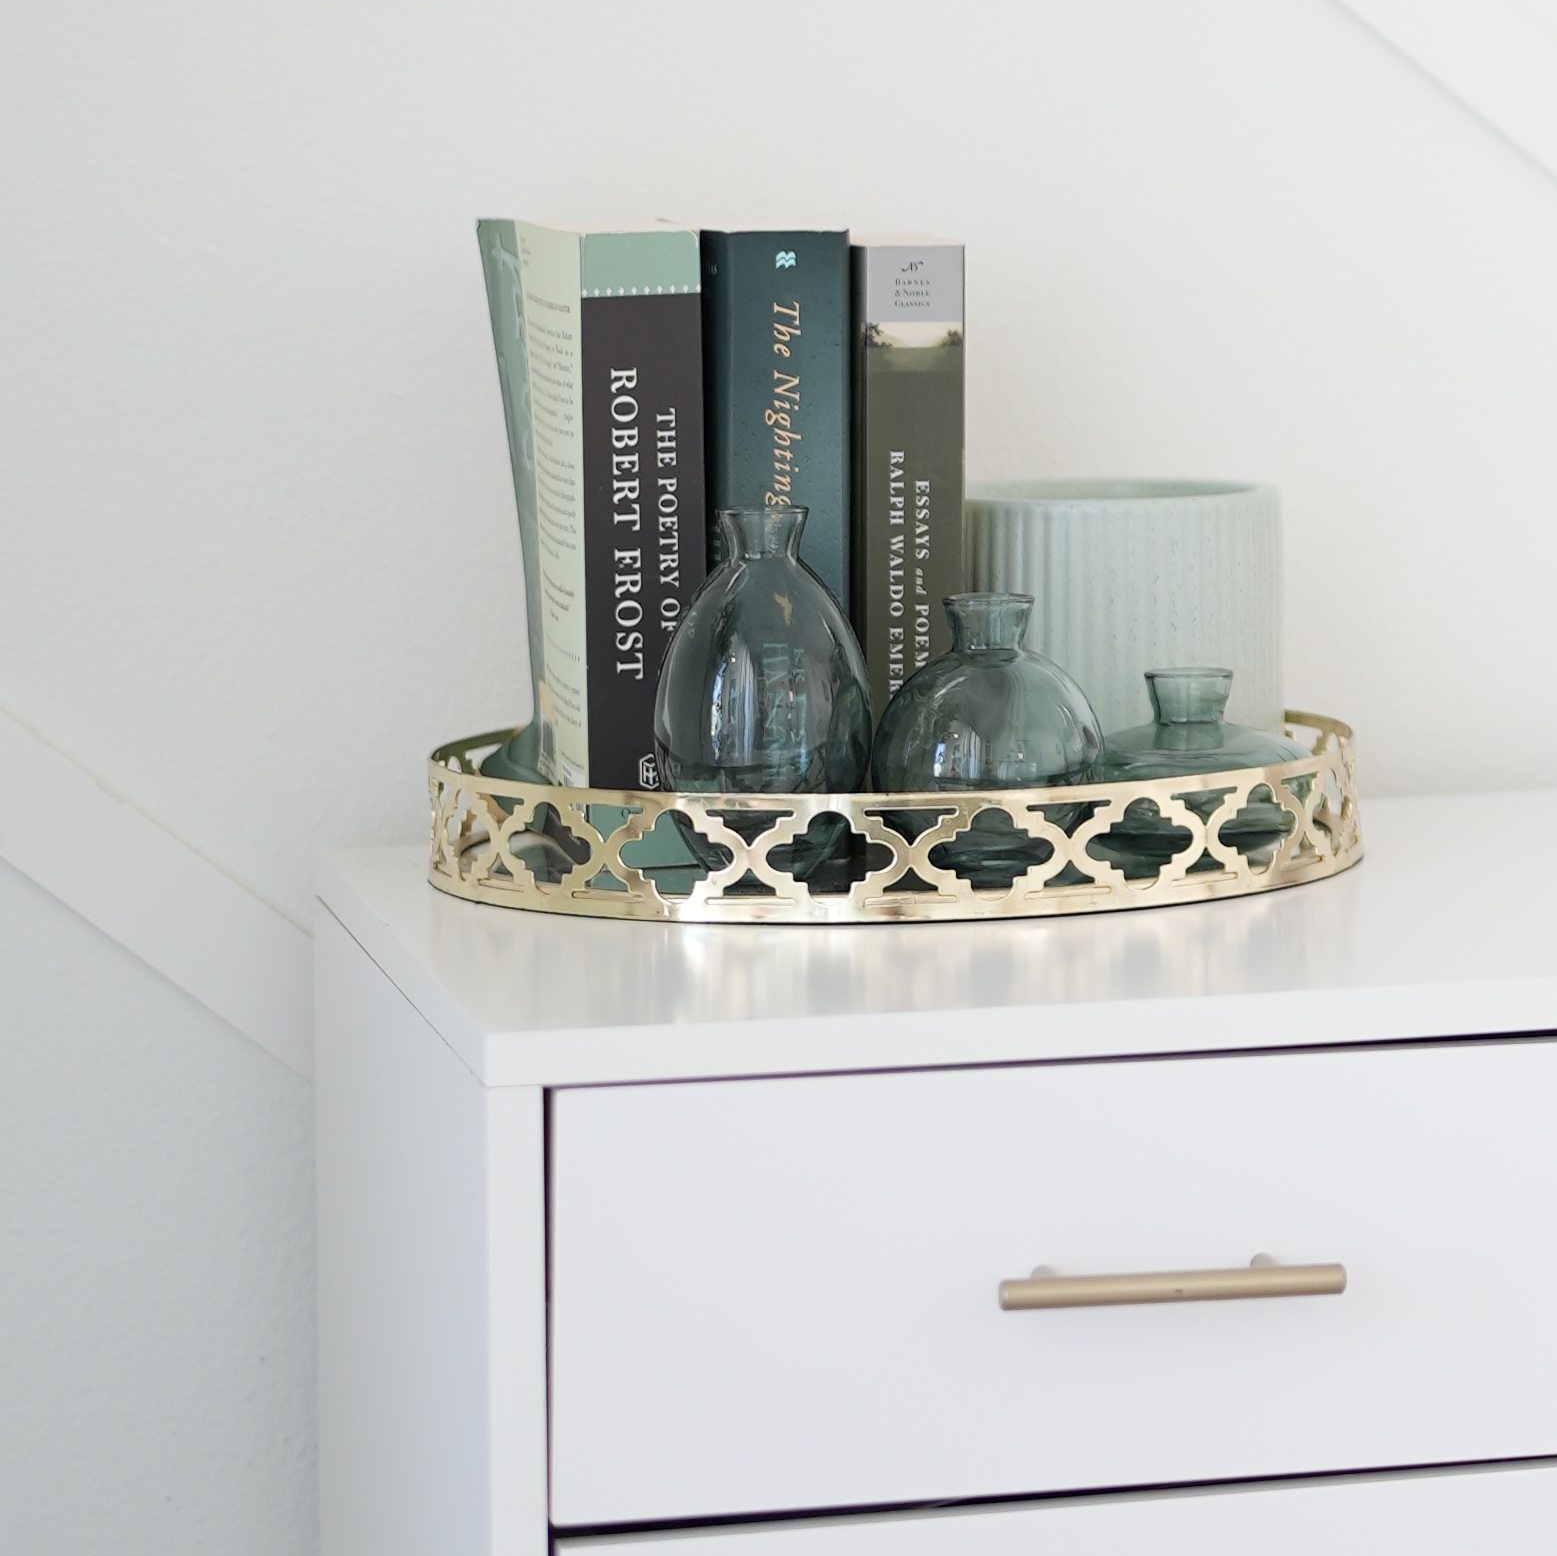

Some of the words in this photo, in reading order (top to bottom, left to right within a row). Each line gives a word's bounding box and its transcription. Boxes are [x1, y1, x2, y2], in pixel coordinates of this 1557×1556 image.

[773, 300, 802, 358] The
[610, 367, 641, 532] ROBERT
[656, 407, 676, 468] THE
[765, 369, 802, 506] Nighting
[889, 450, 905, 526] RALPH
[915, 480, 930, 560] ESSAYS
[657, 477, 680, 588] POETRY
[614, 547, 644, 680] FROST
[889, 534, 905, 618] WALDO
[915, 567, 927, 596] and
[889, 627, 904, 700] EMER
[914, 603, 930, 668] POEM
